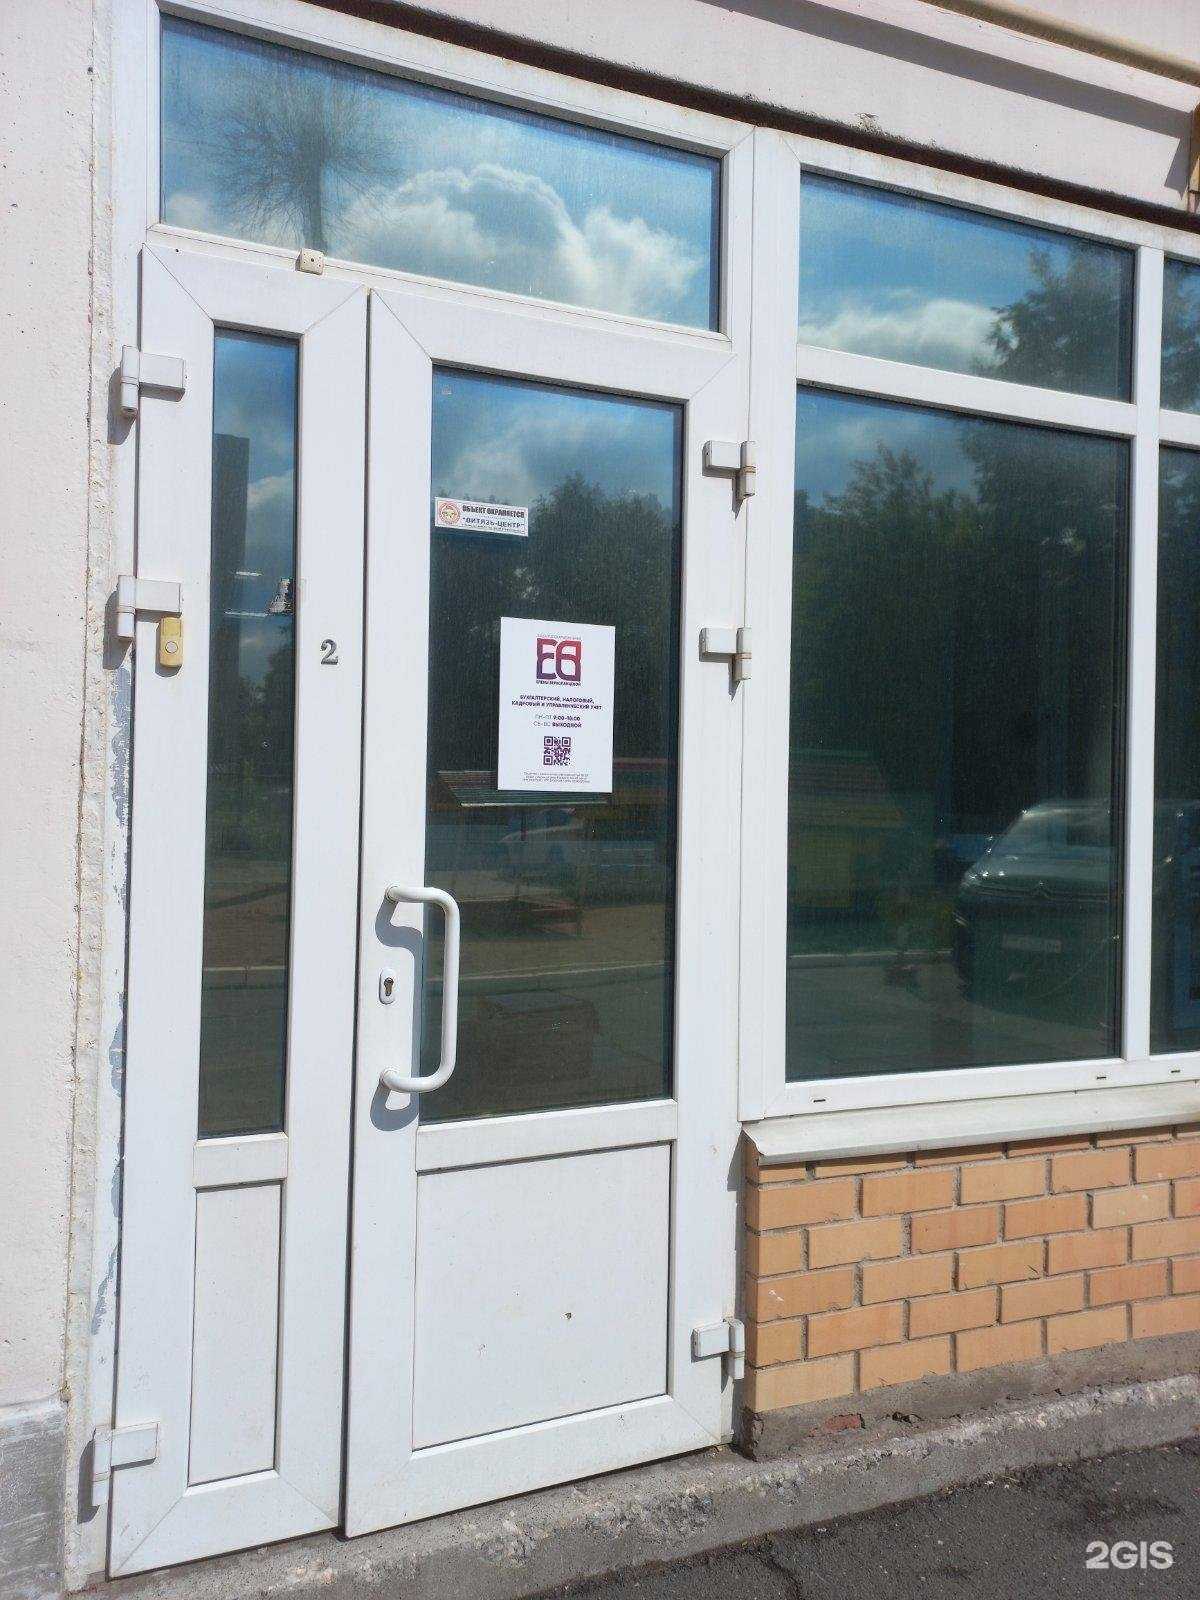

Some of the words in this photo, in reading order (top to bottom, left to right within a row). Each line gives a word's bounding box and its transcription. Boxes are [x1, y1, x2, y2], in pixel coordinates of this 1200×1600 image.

[462, 505, 486, 514] ОБЪЕКТ
[487, 507, 525, 518] ОХРАНЯЕТСЯ
[320, 639, 338, 665] 2
